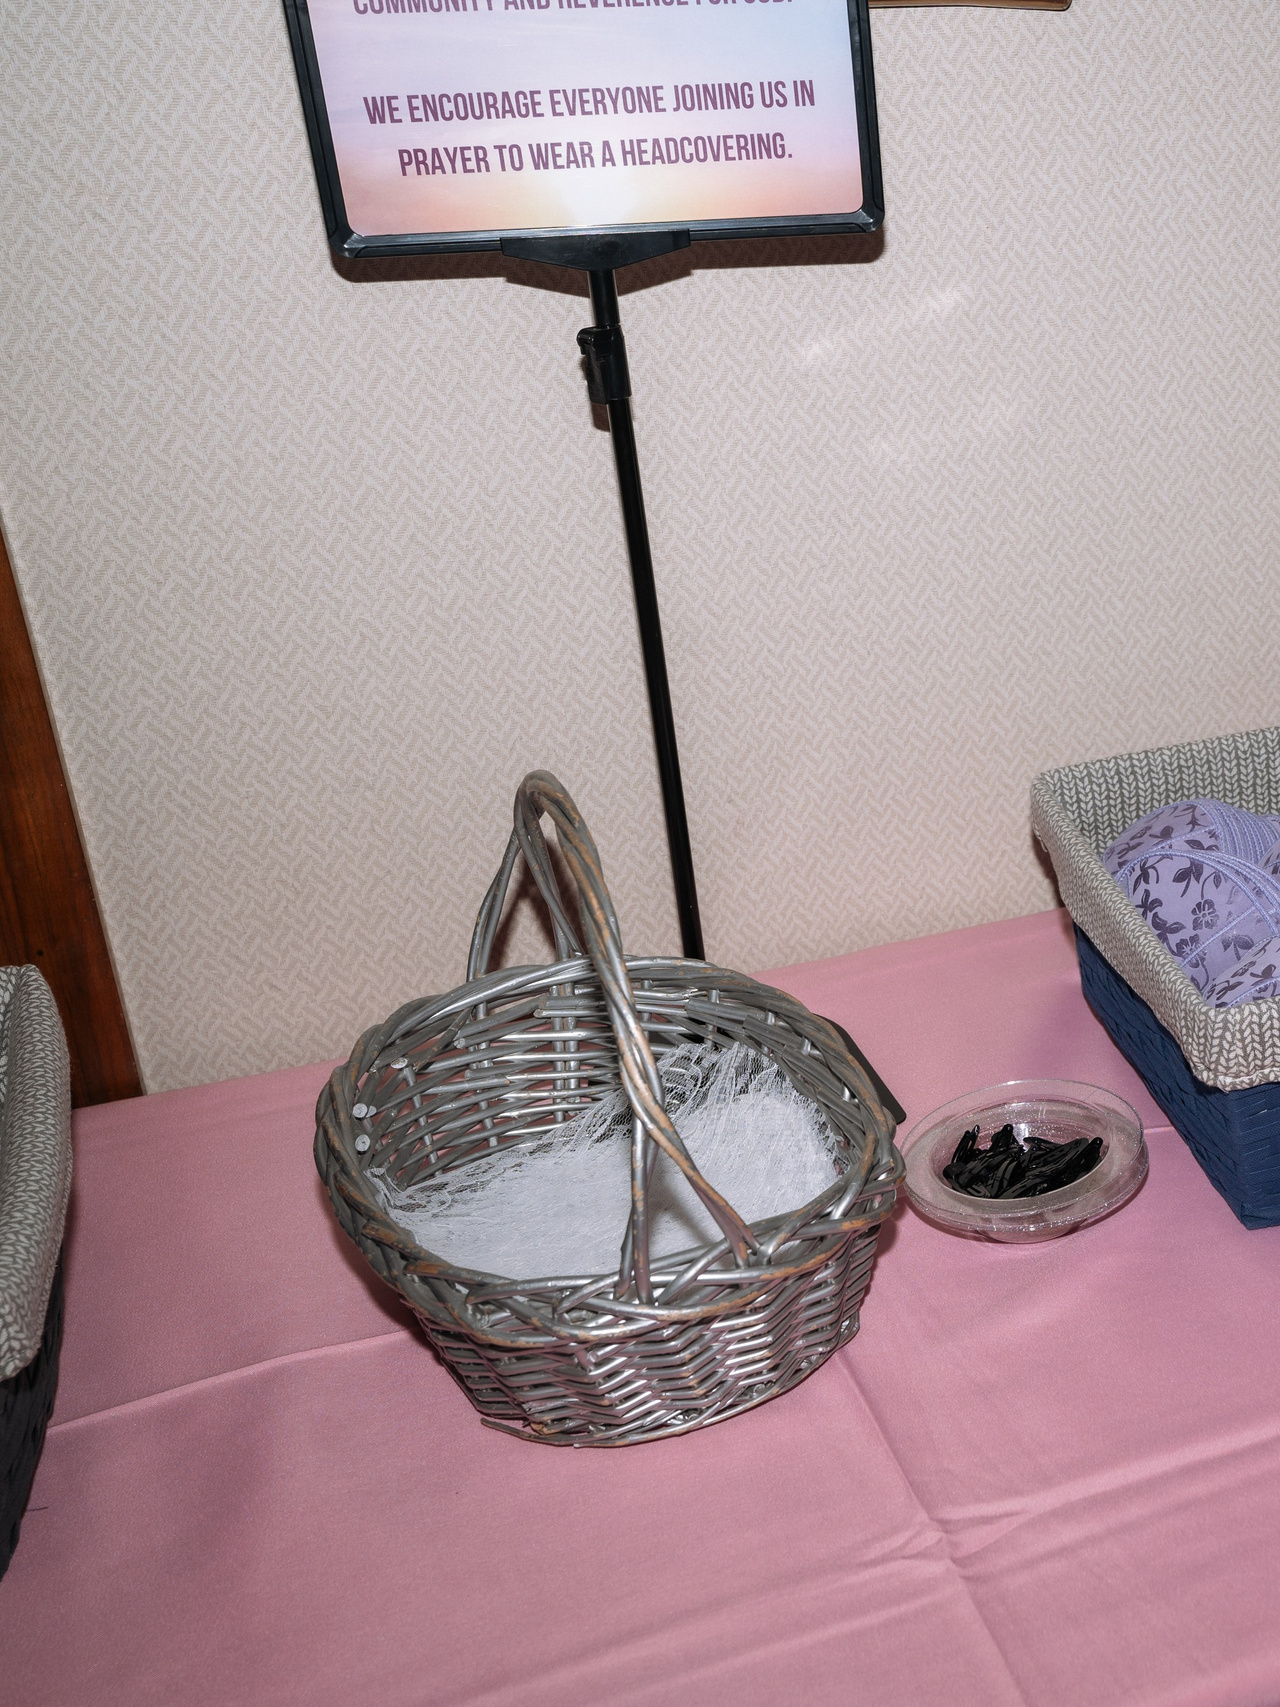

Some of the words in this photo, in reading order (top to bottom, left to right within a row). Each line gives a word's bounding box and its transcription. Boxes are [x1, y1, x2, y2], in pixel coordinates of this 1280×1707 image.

[362, 95, 403, 125] WE
[406, 90, 545, 123] ENCOURAGE
[549, 85, 667, 117] EVERYONE
[672, 81, 755, 112] JOINING
[759, 80, 788, 109] US
[792, 79, 816, 107] IN
[398, 145, 491, 177] PRAYER
[493, 143, 524, 172] TO
[528, 141, 596, 171] WEAR
[601, 140, 617, 167] A
[620, 132, 793, 167] HEADCOVERING.
